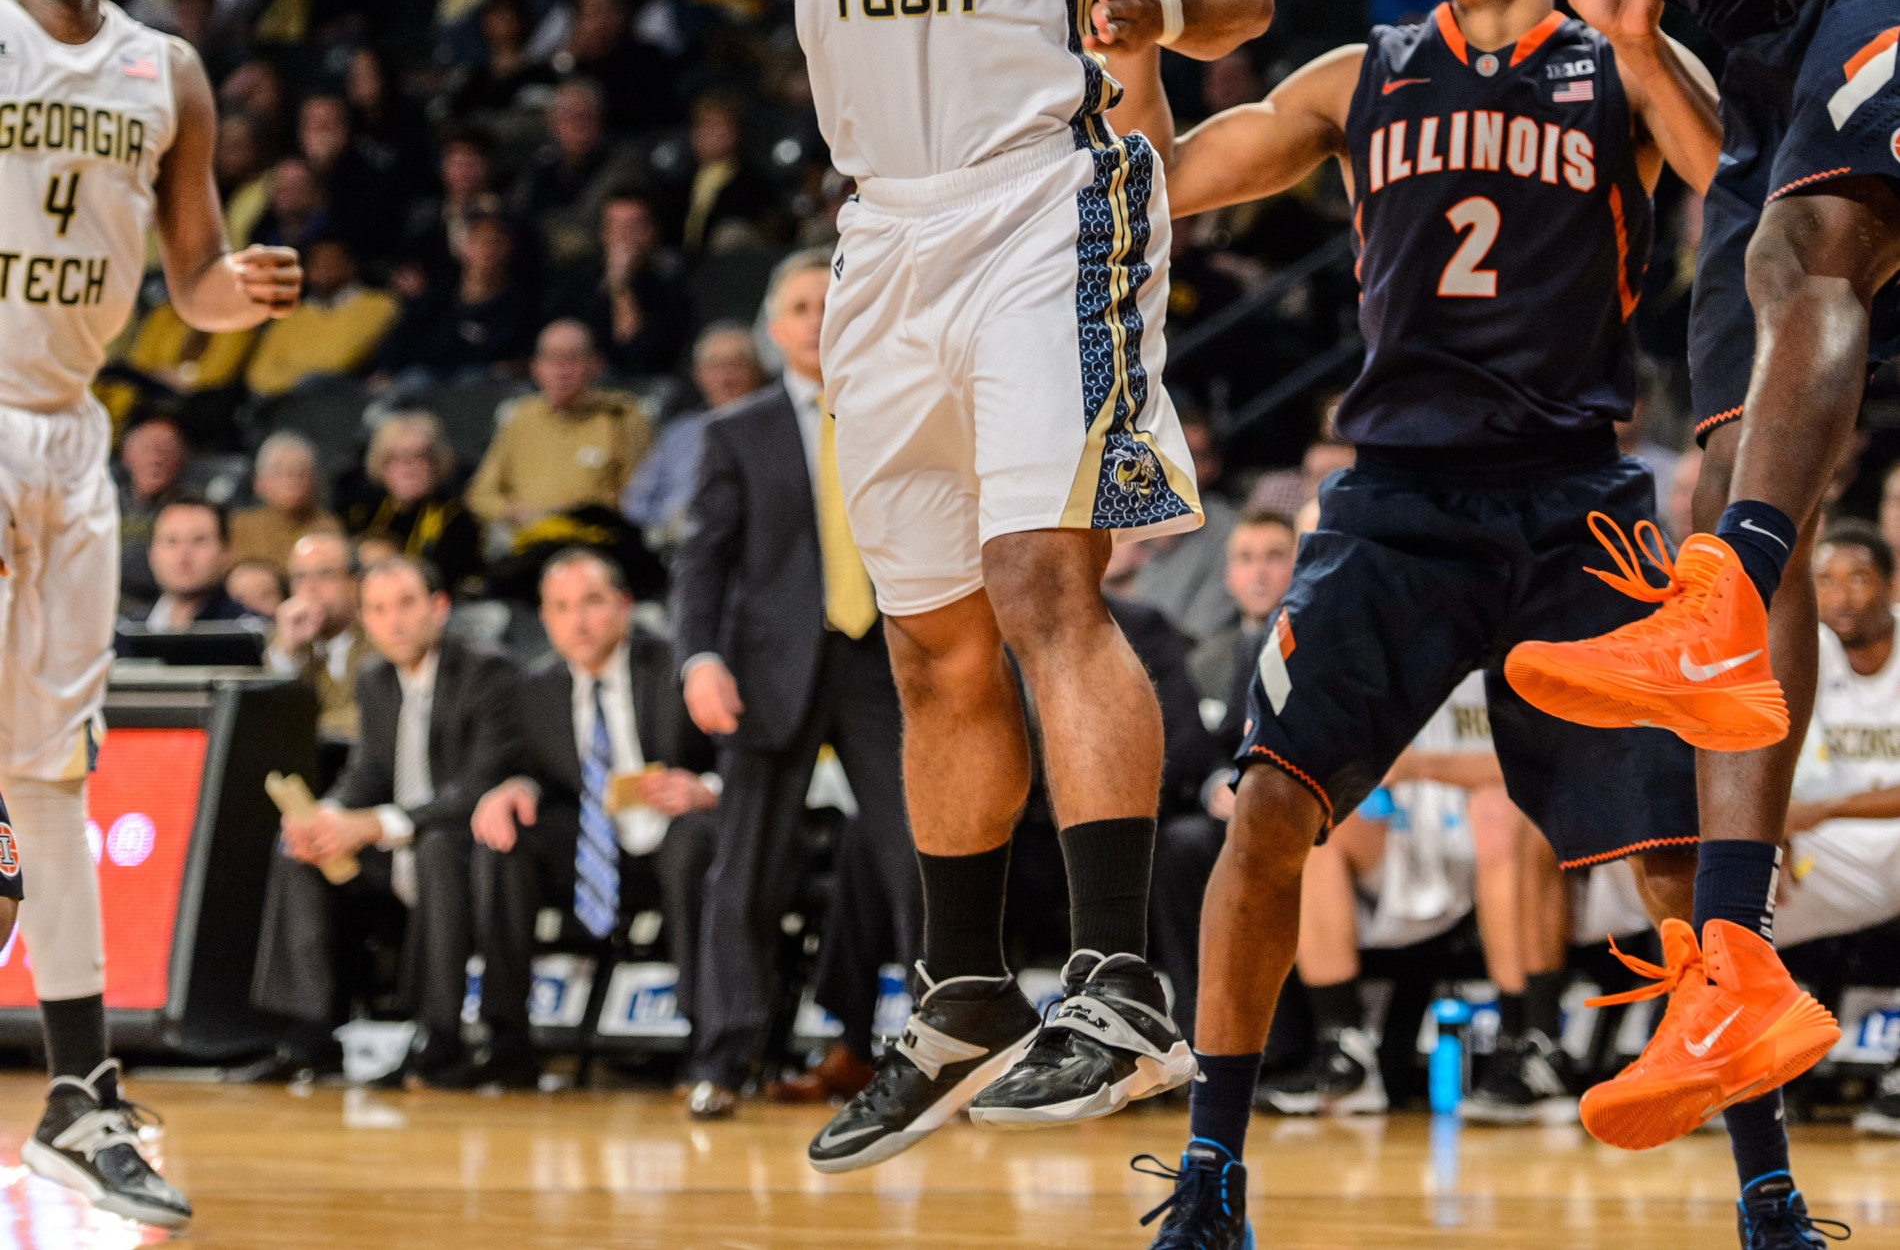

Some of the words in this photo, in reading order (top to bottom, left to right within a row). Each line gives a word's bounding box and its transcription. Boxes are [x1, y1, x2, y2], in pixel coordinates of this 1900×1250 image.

[0, 101, 145, 168] GEORGIA
[1369, 110, 1597, 193] ILLINOIS
[42, 169, 82, 240] 4
[0, 250, 108, 306] TECH
[1437, 195, 1501, 298] 2
